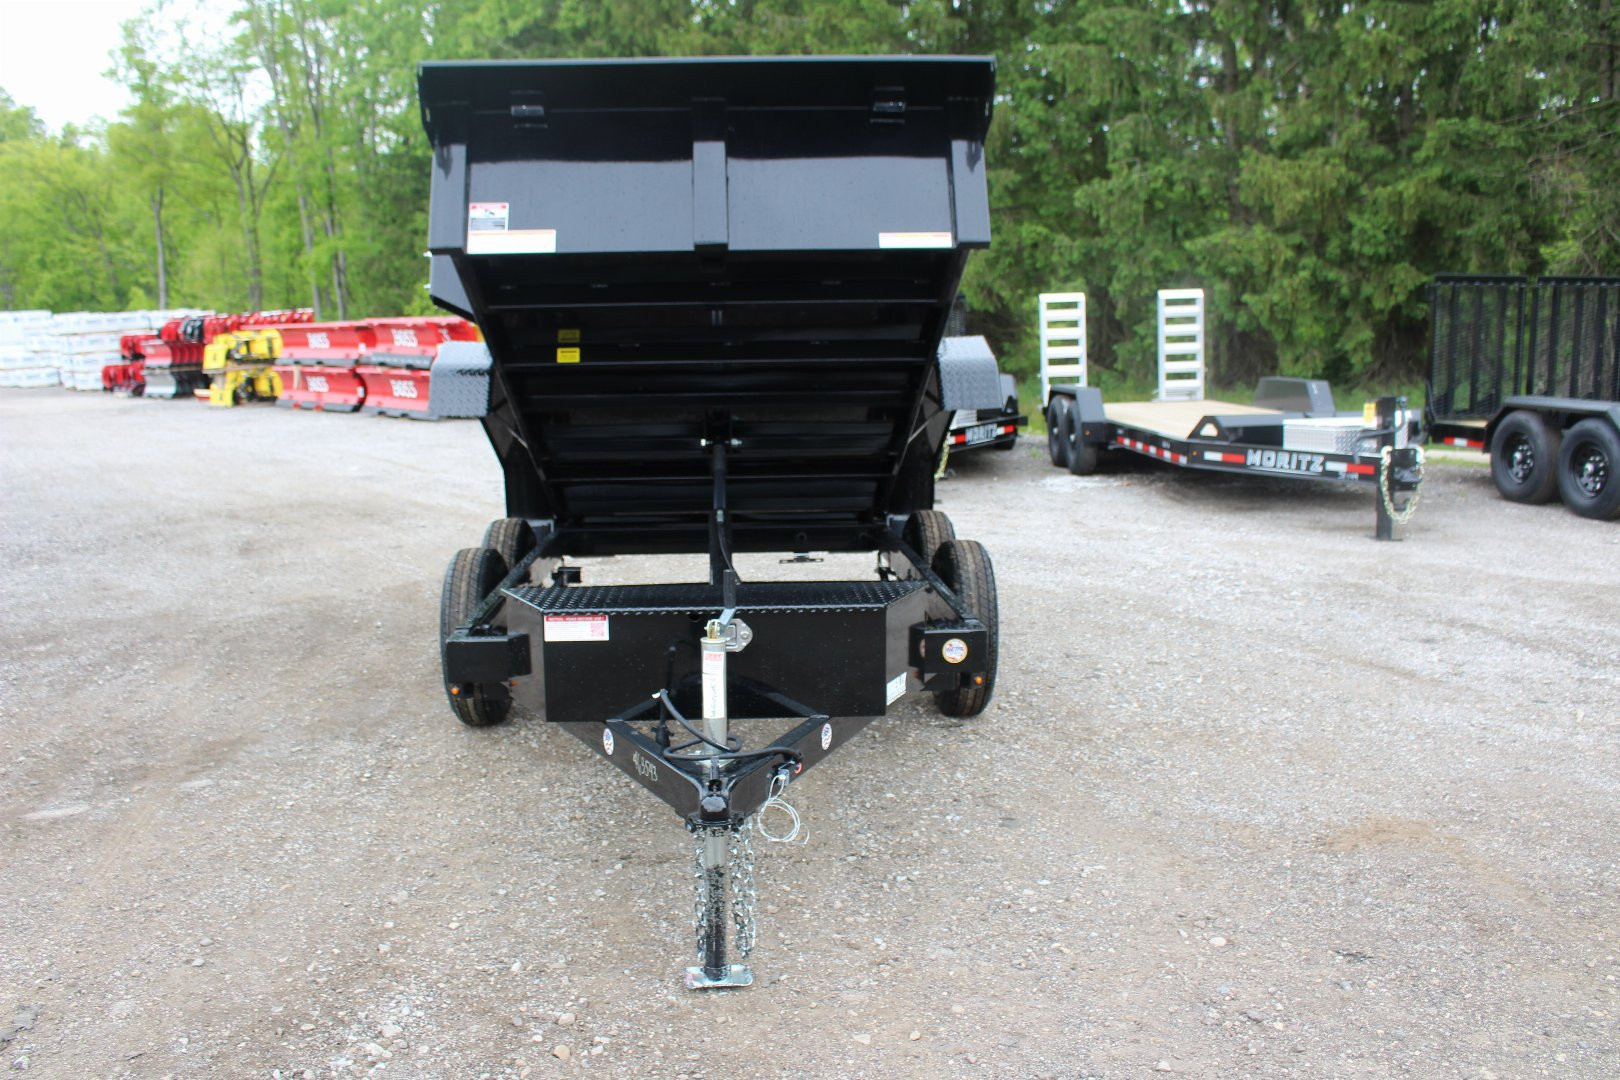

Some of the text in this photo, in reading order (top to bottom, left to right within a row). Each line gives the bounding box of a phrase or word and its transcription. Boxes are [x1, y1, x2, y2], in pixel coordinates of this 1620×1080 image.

[306, 332, 331, 349] BOSS
[391, 329, 419, 348] BOSS
[306, 376, 330, 393] BOSS
[390, 379, 418, 399] BOSS
[1246, 448, 1325, 473] MORITZ
